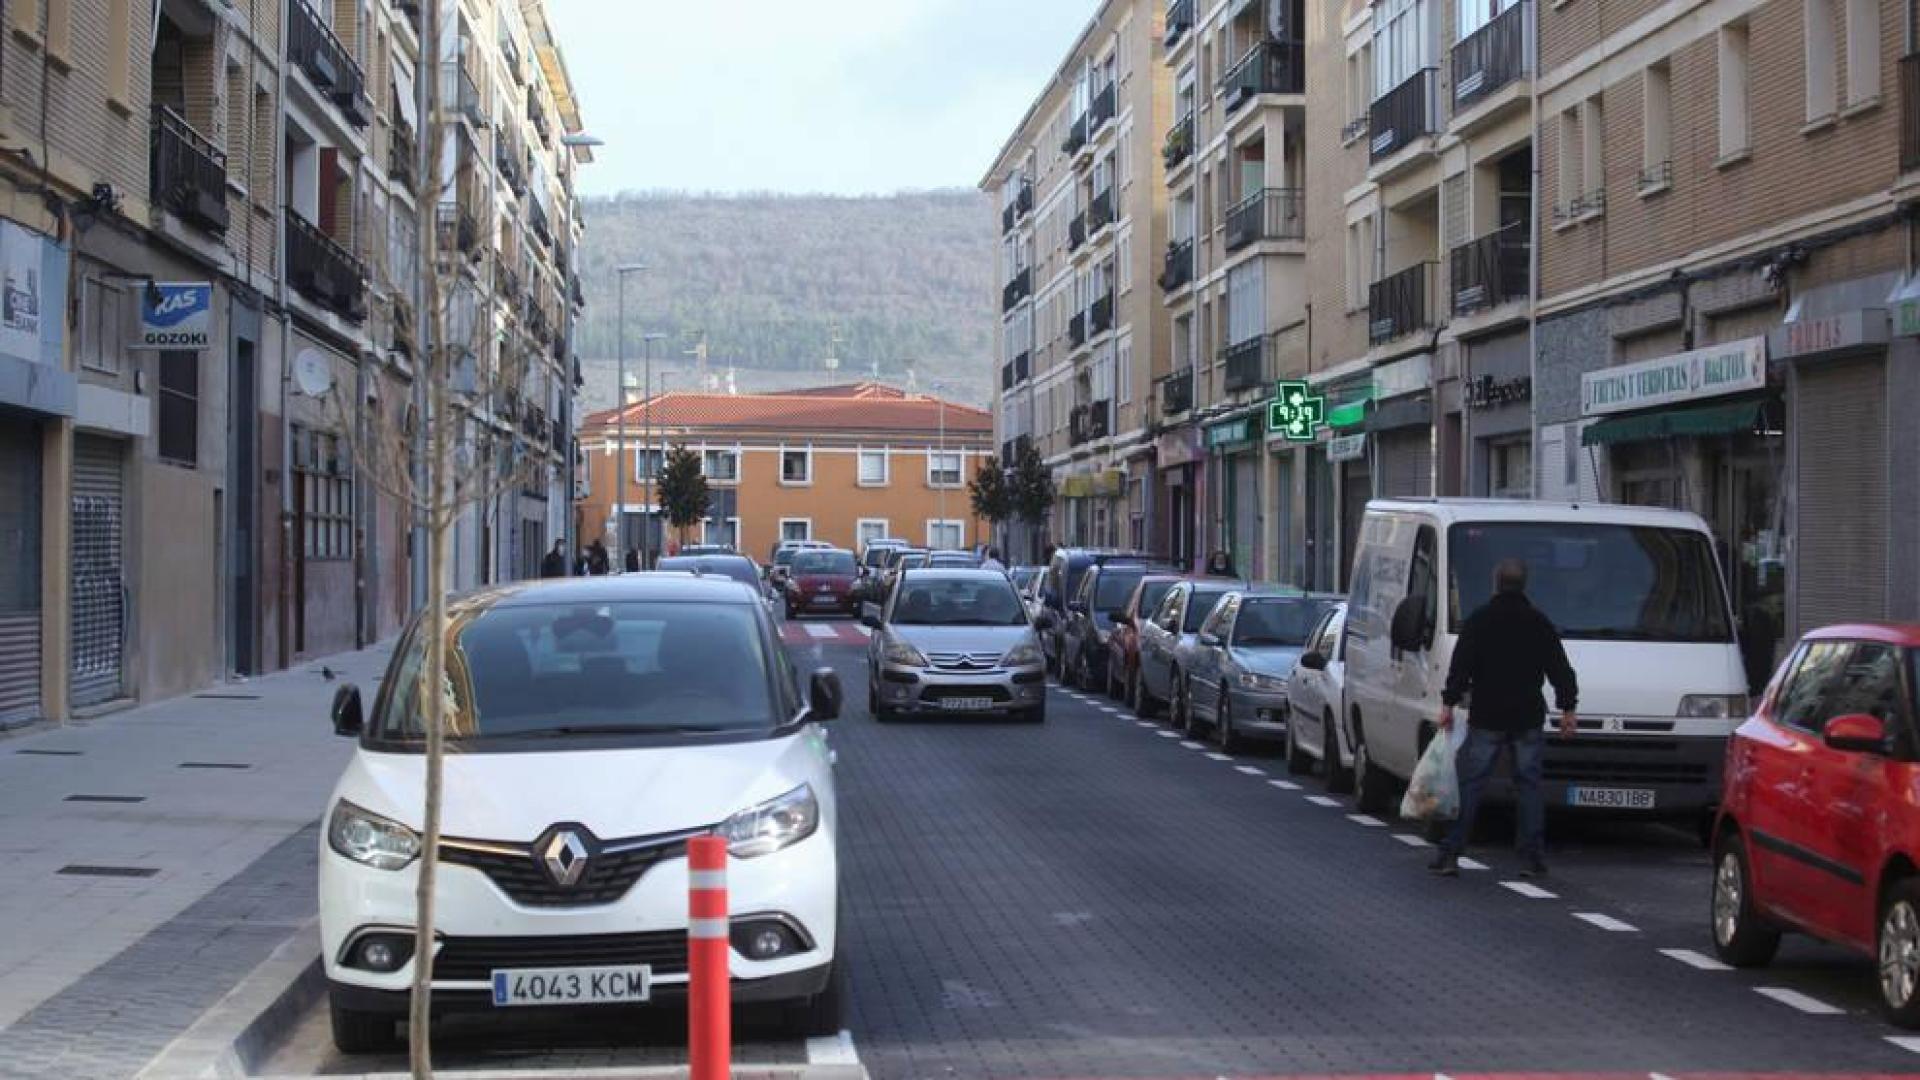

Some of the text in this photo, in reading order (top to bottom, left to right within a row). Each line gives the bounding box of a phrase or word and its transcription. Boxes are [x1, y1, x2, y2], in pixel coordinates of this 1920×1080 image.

[154, 289, 197, 317] KAS
[145, 332, 208, 345] GOZOKI
[1279, 406, 1313, 421] 9:19
[513, 971, 643, 1000] 4043 KCM
